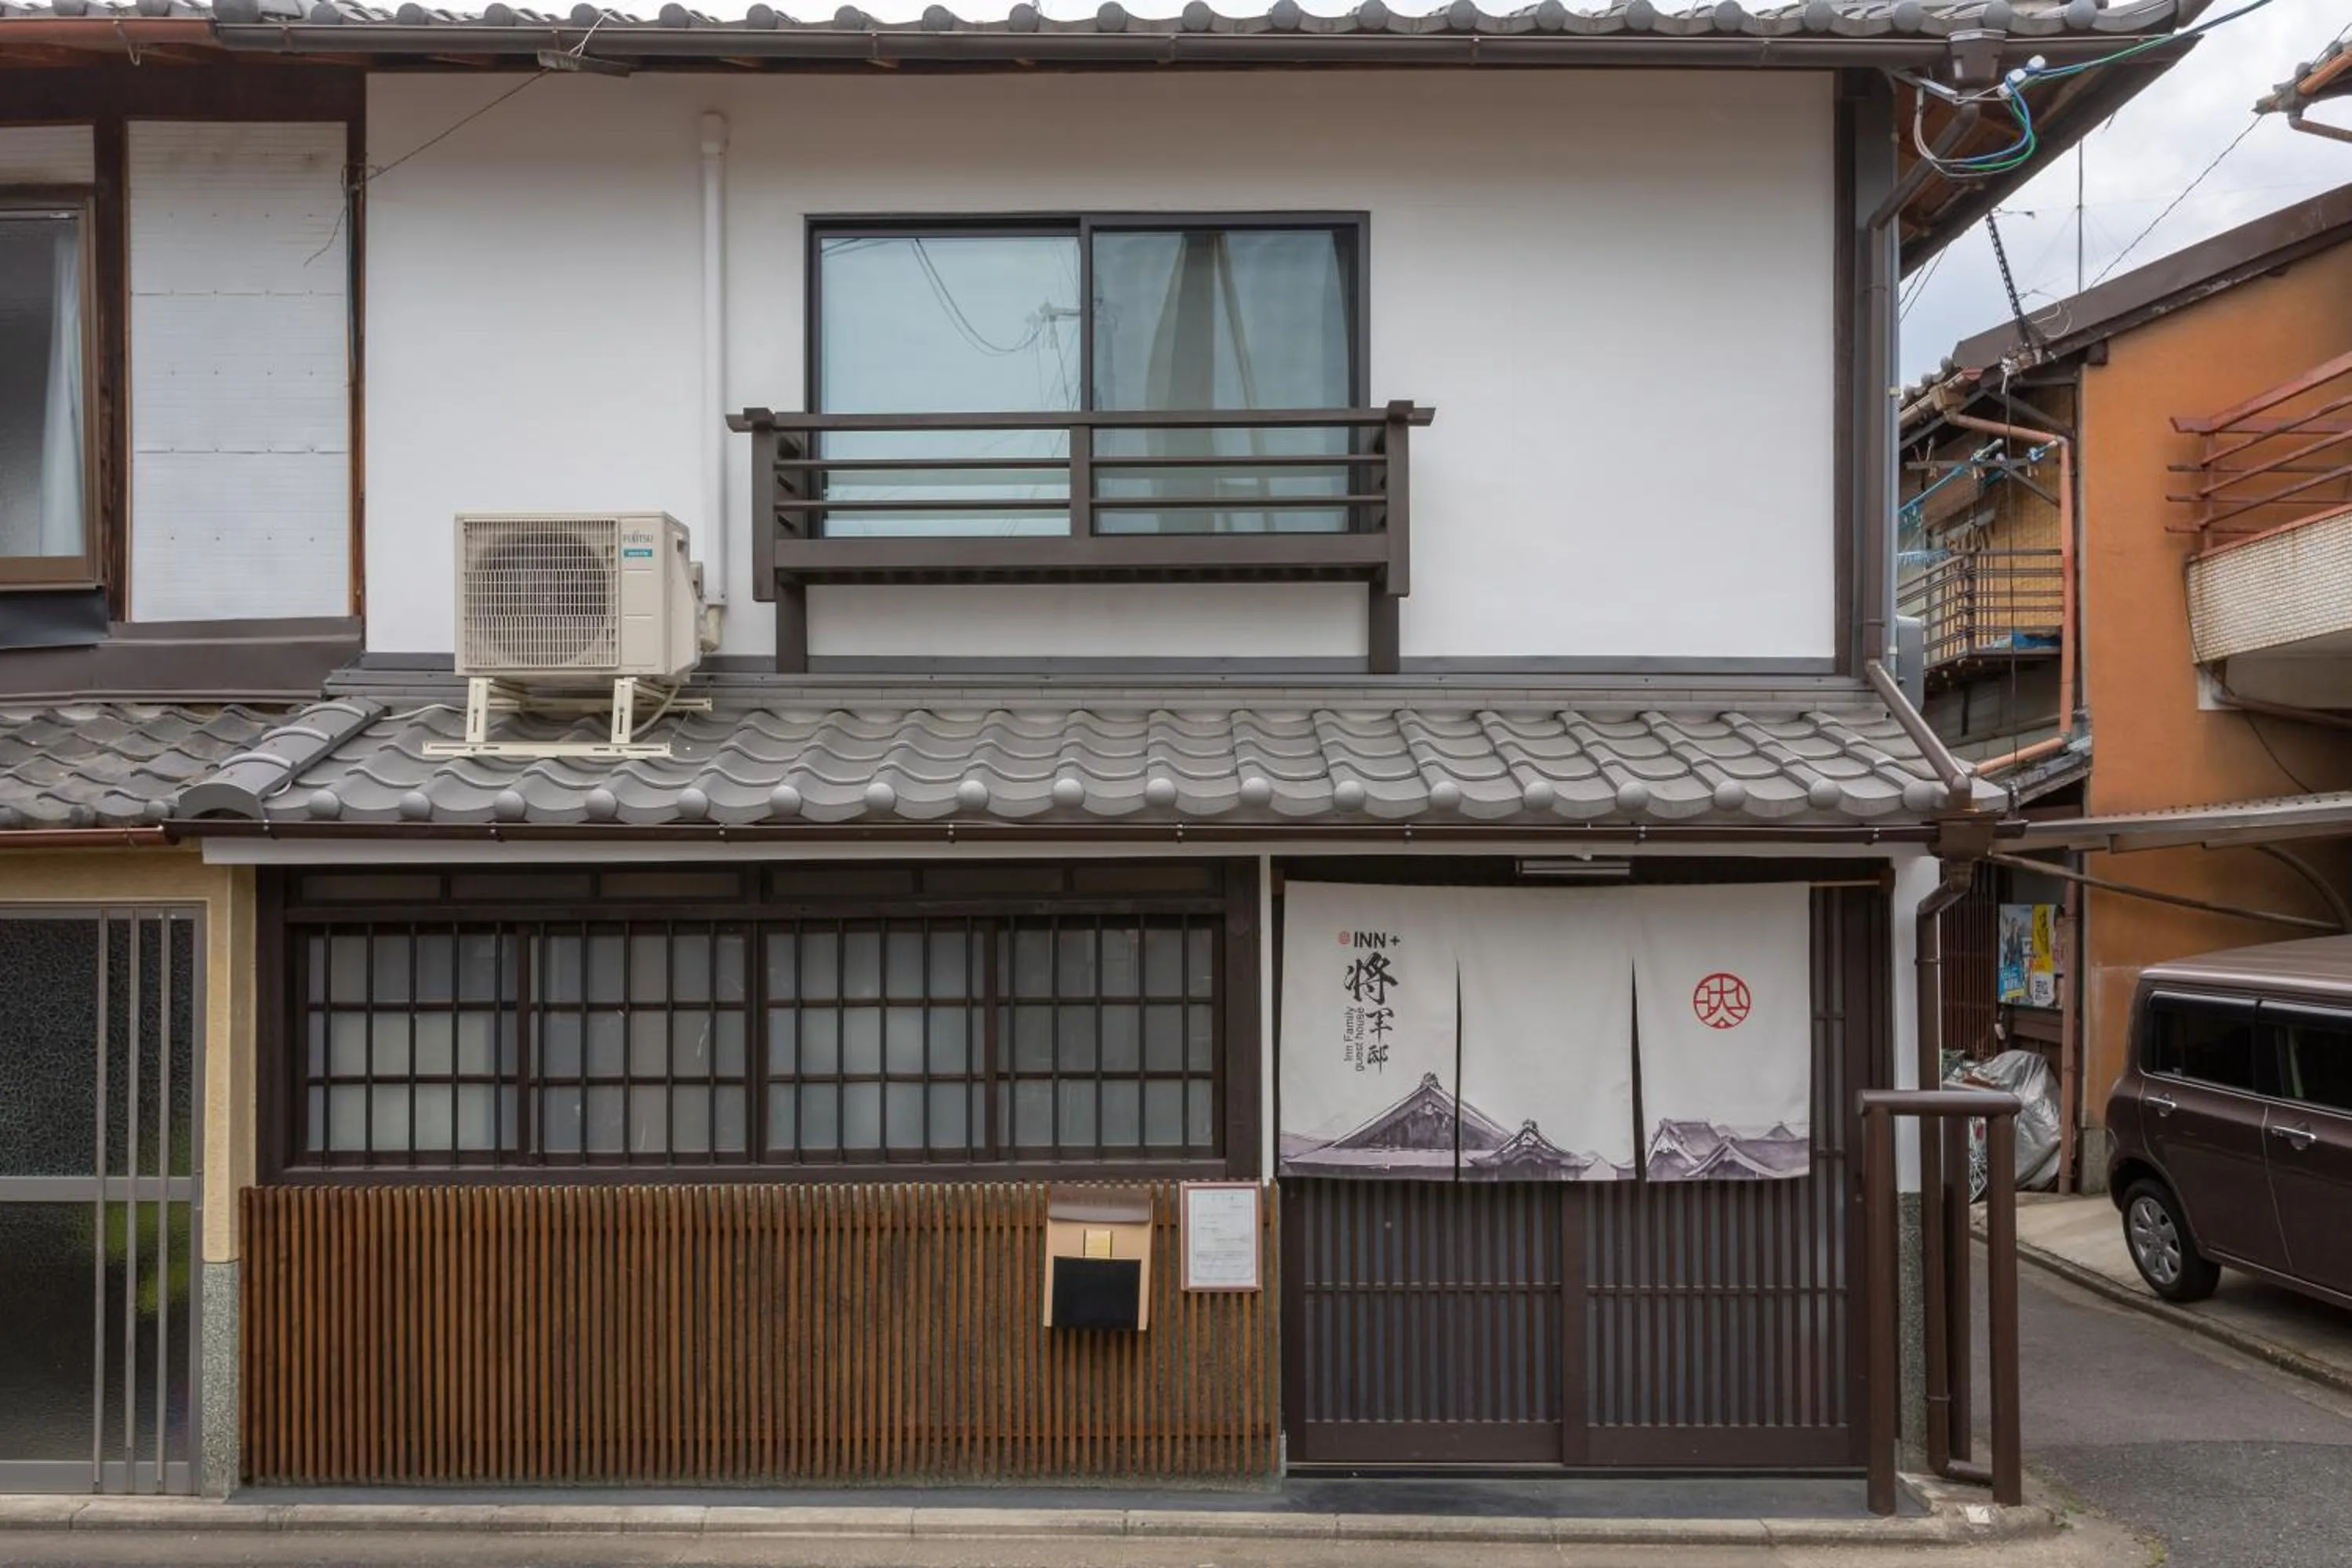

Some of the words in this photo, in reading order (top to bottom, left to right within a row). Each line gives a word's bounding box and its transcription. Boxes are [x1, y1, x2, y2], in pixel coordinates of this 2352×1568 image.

[1343, 1006, 1356, 1041] Family
[1355, 1007, 1365, 1040] house
[1343, 1044, 1353, 1062] Inn
[1355, 1042, 1365, 1073] guest
